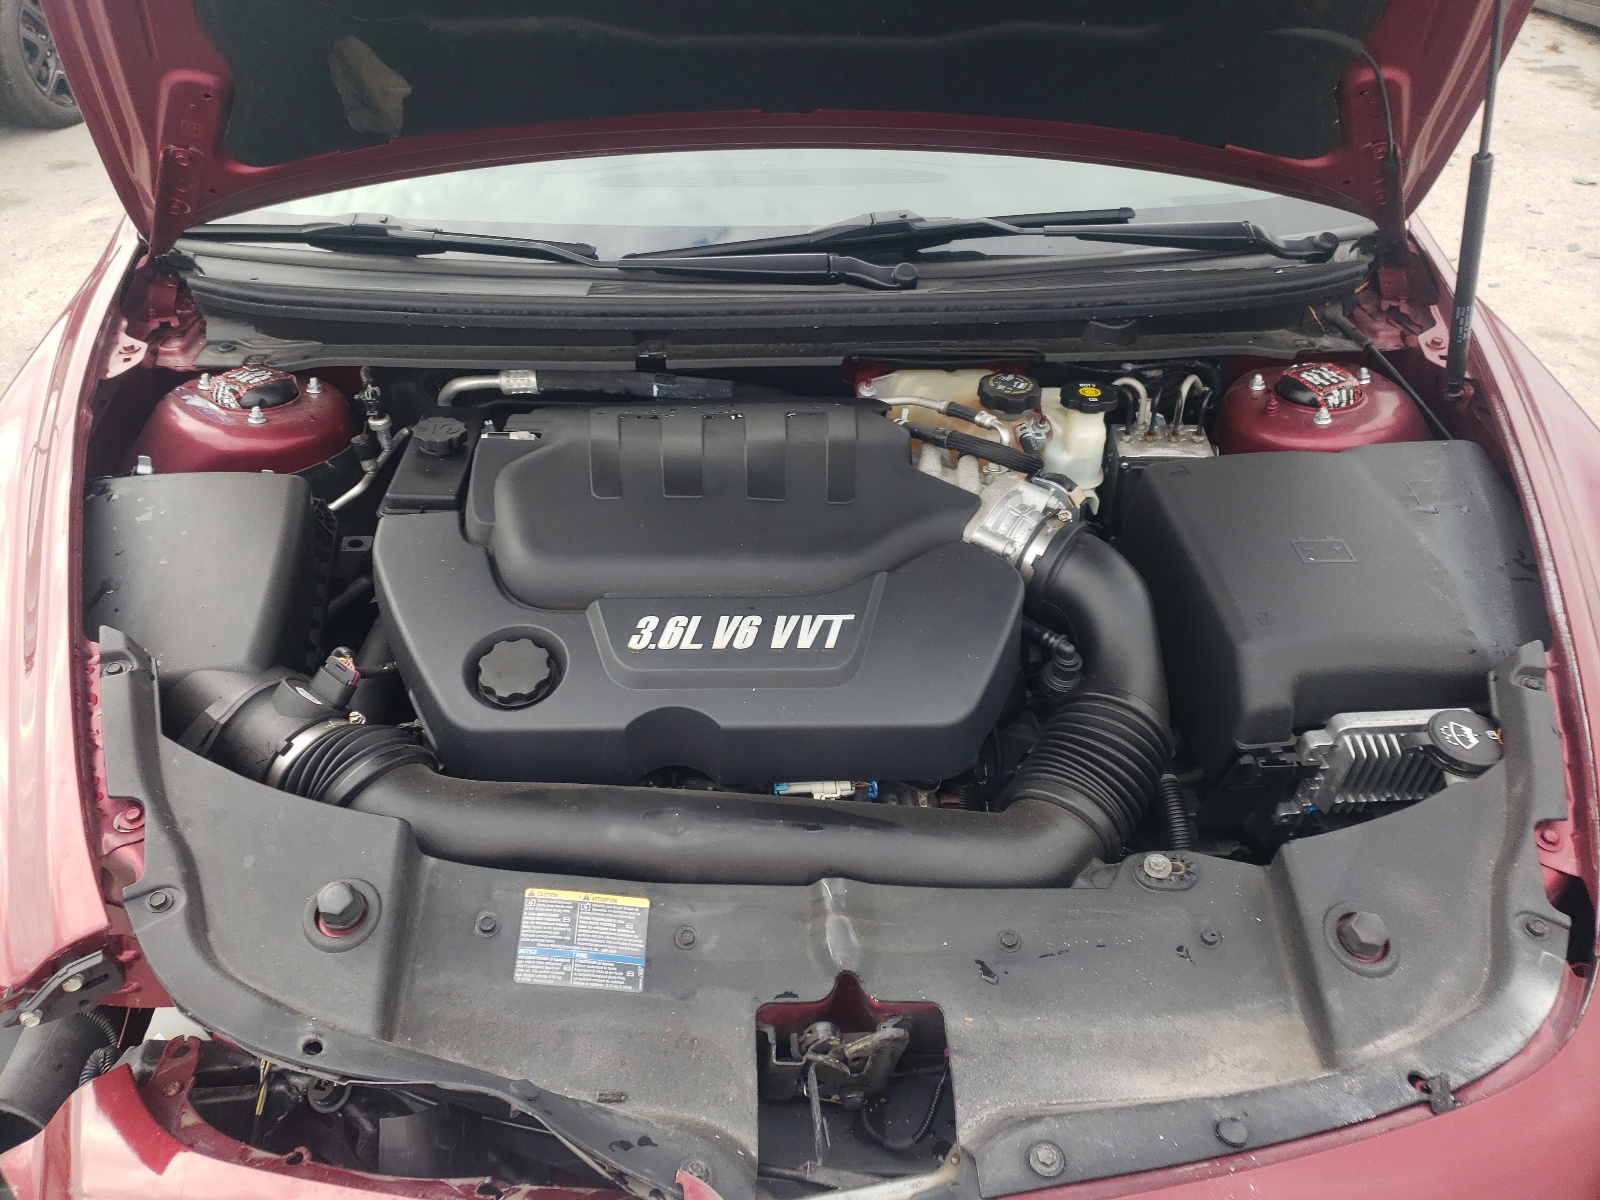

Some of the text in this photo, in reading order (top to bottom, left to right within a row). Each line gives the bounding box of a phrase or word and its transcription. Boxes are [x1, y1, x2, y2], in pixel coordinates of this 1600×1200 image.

[627, 613, 856, 650] 3.6L V6 VVT
